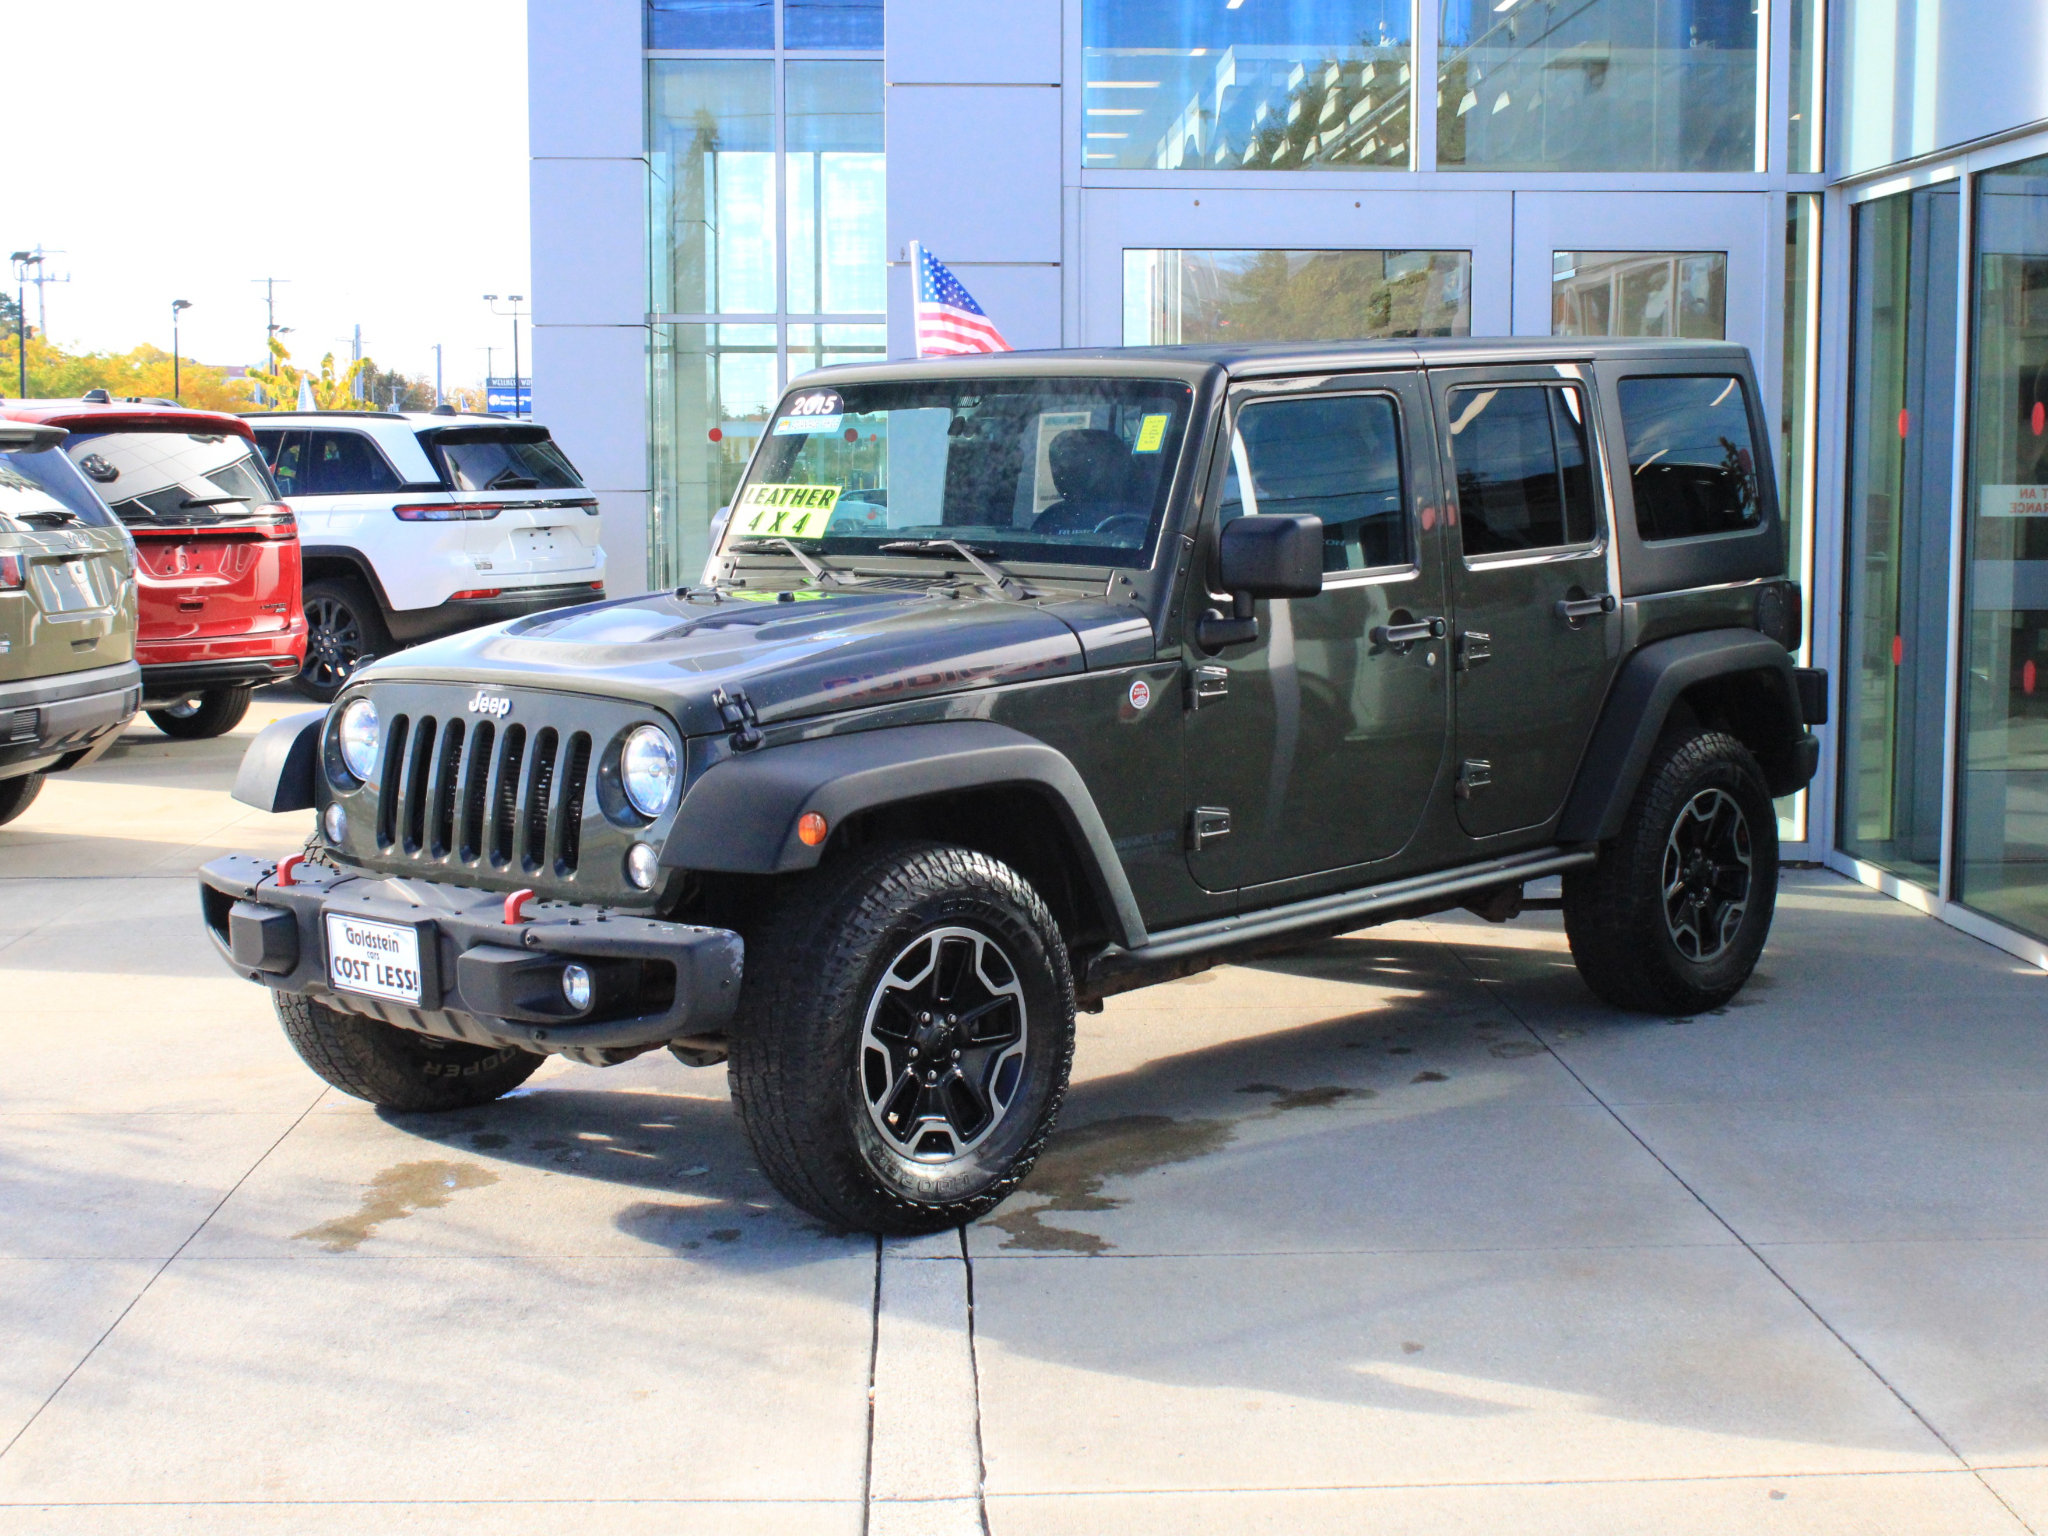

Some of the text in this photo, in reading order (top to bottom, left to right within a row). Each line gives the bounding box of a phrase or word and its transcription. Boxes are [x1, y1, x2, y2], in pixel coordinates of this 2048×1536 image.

[791, 395, 837, 415] 2015
[744, 487, 836, 509] LEATHER
[468, 690, 511, 718] Jeep
[346, 927, 399, 953] Goldstein
[366, 951, 380, 961] cars
[334, 956, 418, 992] COST LESS!
